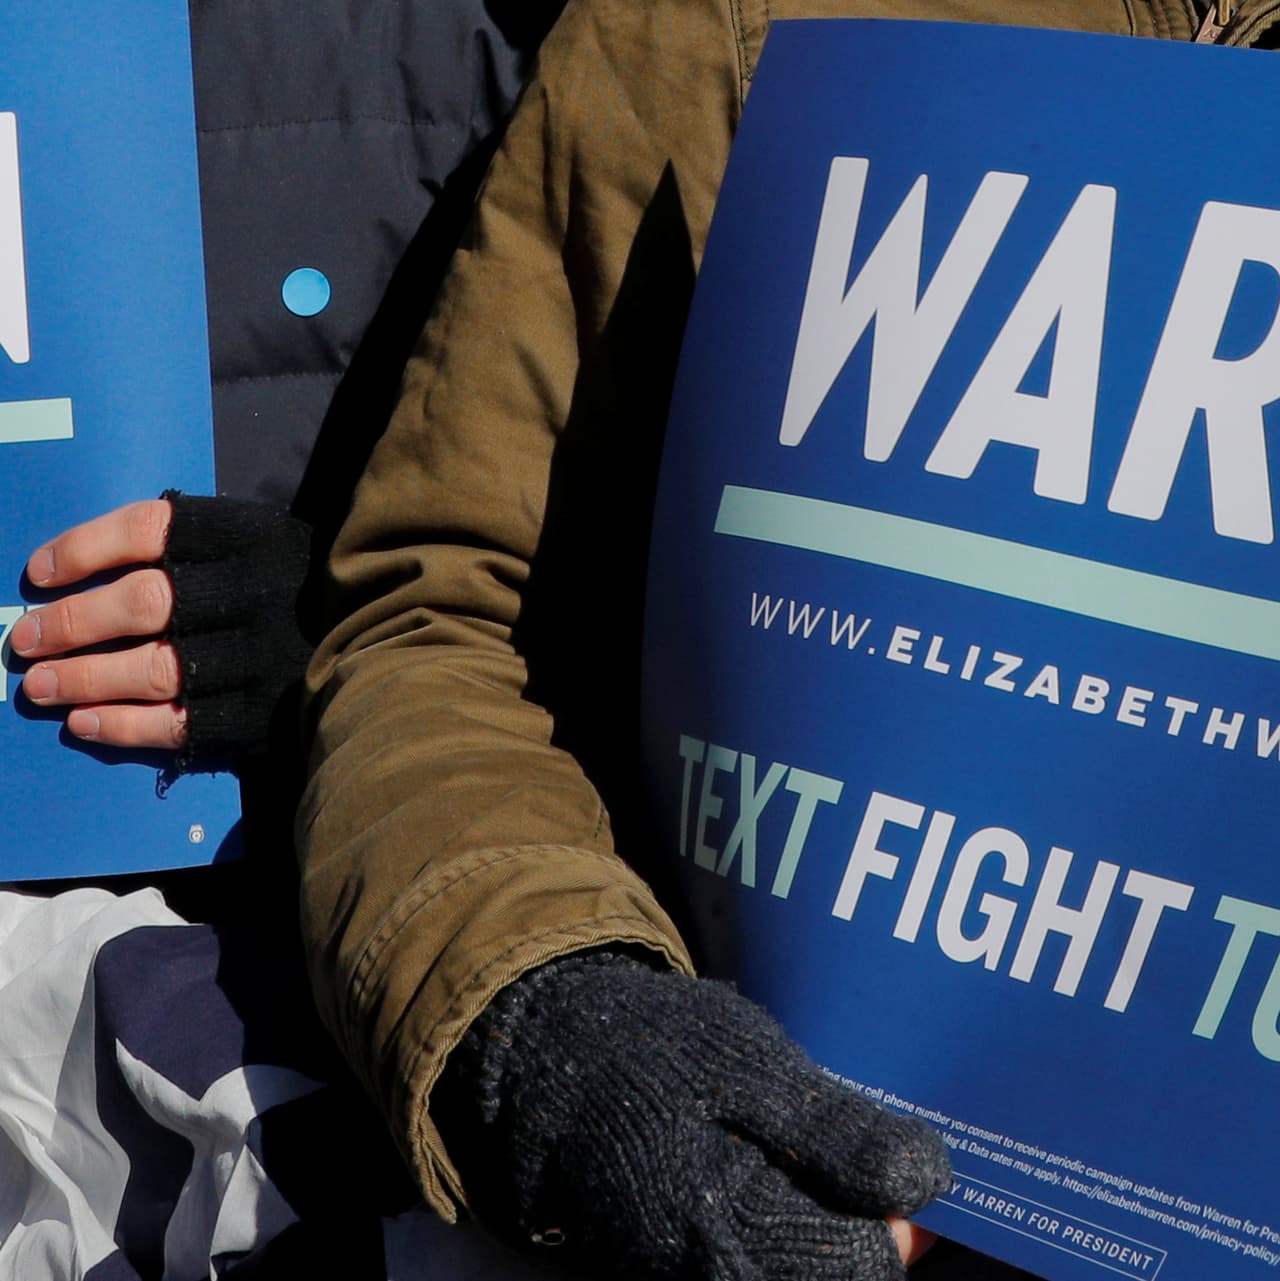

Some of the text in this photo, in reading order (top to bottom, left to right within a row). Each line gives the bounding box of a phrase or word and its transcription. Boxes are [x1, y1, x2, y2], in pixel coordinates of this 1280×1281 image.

[678, 734, 845, 899] TEXT
[831, 790, 1193, 1014] FIGHT
[864, 1085, 884, 1100] cell
[883, 1093, 915, 1113] phone
[914, 1106, 951, 1125] number
[949, 1119, 968, 1133] you
[967, 1125, 1004, 1145] consent
[1003, 1136, 1015, 1148] to
[1014, 1141, 1046, 1160] receive
[1045, 1151, 1086, 1174] periodic
[1085, 1166, 1133, 1191] campaign
[1132, 1183, 1175, 1207] updates
[1175, 1196, 1201, 1216] from
[1201, 1204, 1242, 1230] Warren
[1242, 1219, 1260, 1236] for
[958, 1138, 969, 1151] &
[967, 1141, 990, 1160] Data
[988, 1149, 1015, 1168] rates
[1013, 1159, 1034, 1176] may
[963, 1186, 1027, 1222] WARREN
[1027, 1212, 1060, 1235] FOR
[1061, 1225, 1155, 1271] PRESIDENT
